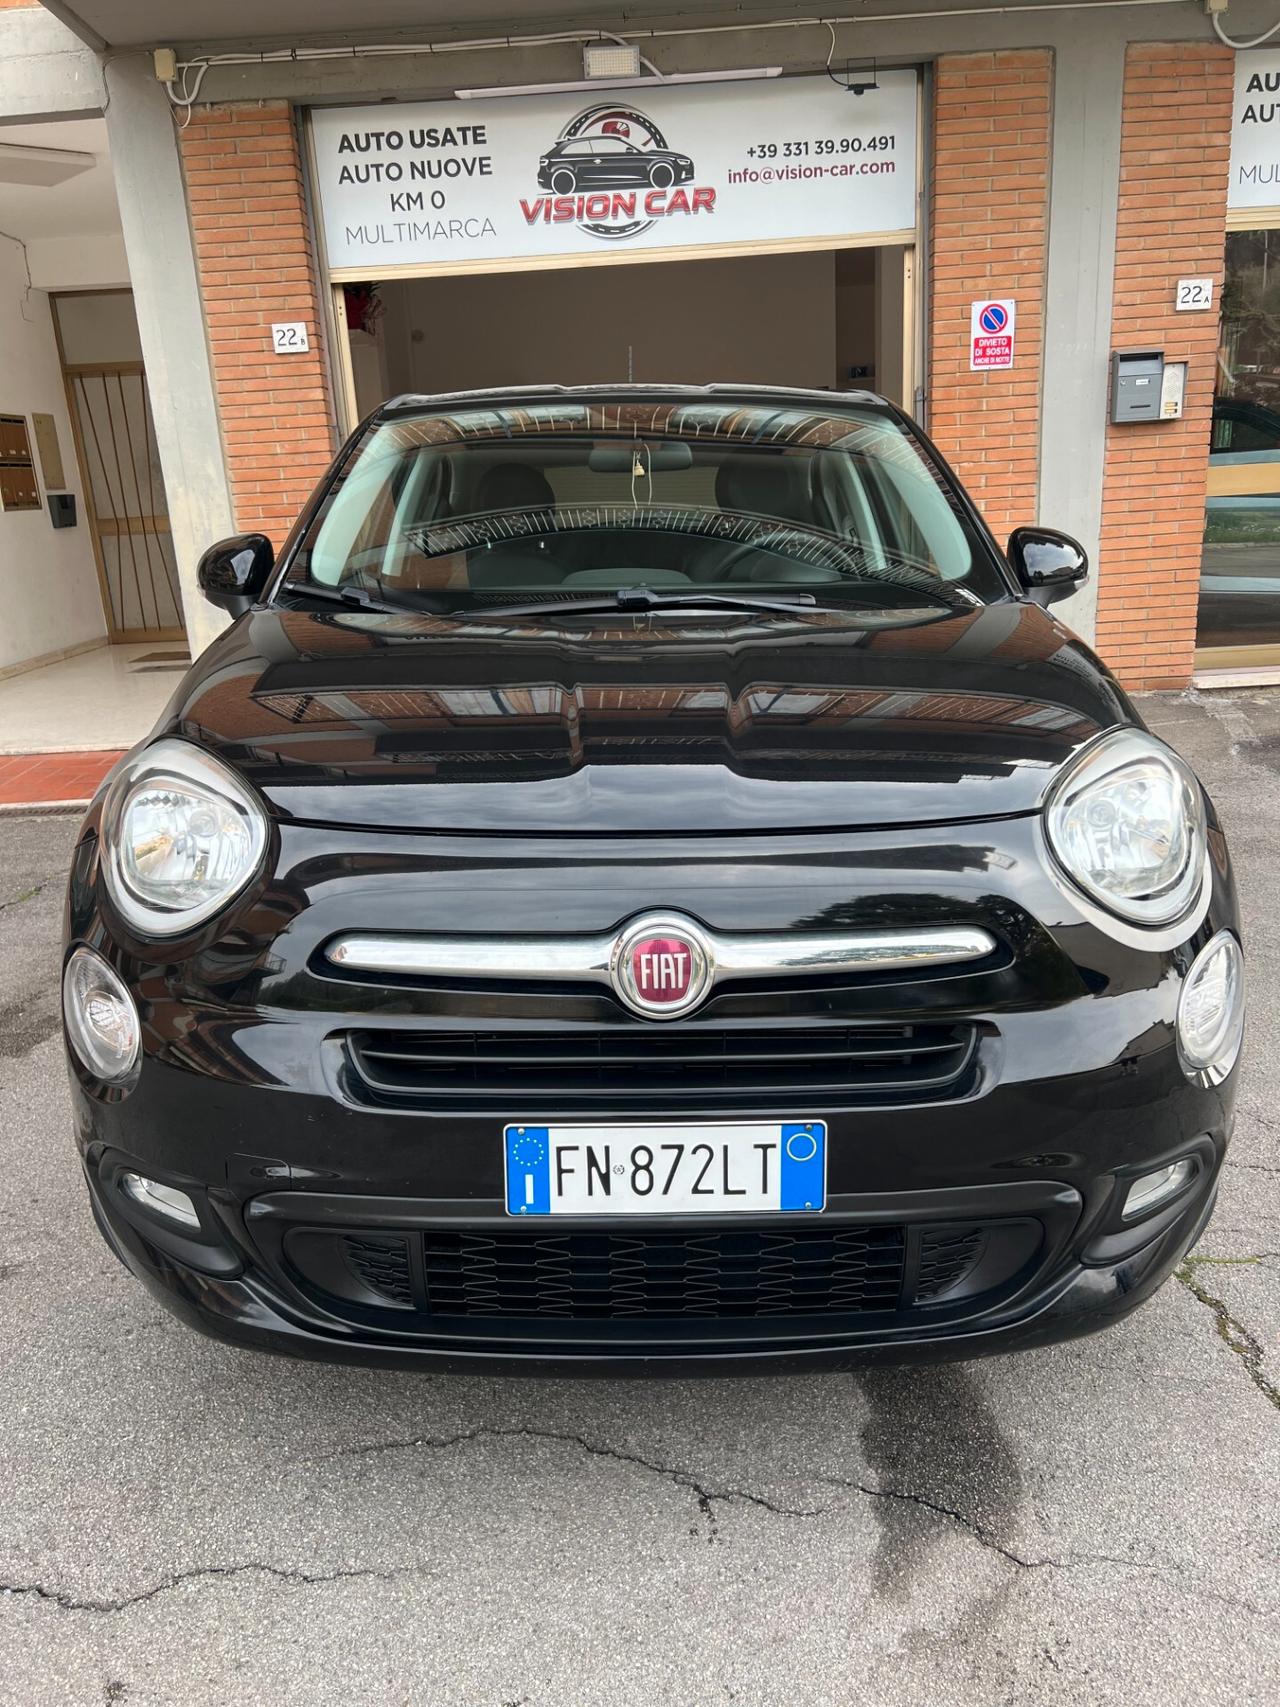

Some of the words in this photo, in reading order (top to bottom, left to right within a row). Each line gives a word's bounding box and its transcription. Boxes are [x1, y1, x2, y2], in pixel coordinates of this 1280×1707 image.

[1241, 103, 1280, 124] AU
[338, 131, 404, 153] AUTO
[409, 126, 487, 148] USATE
[747, 143, 777, 159] +39
[783, 141, 809, 157] 331
[814, 135, 896, 155] 39.90.491
[338, 162, 404, 185] AUTO
[410, 156, 493, 179] NUOVE
[728, 161, 896, 185] info@vision-car.com
[390, 192, 424, 212] KM
[519, 192, 637, 226] VISION
[643, 187, 717, 217] CAR
[345, 218, 497, 246] MULTIMARCA
[974, 348, 983, 357] DI
[986, 346, 1010, 356] SOSTA
[979, 337, 1007, 347] DIVIETO
[640, 953, 687, 989] FIAT
[555, 1145, 612, 1197] FN
[630, 1143, 777, 1196] 872LT
